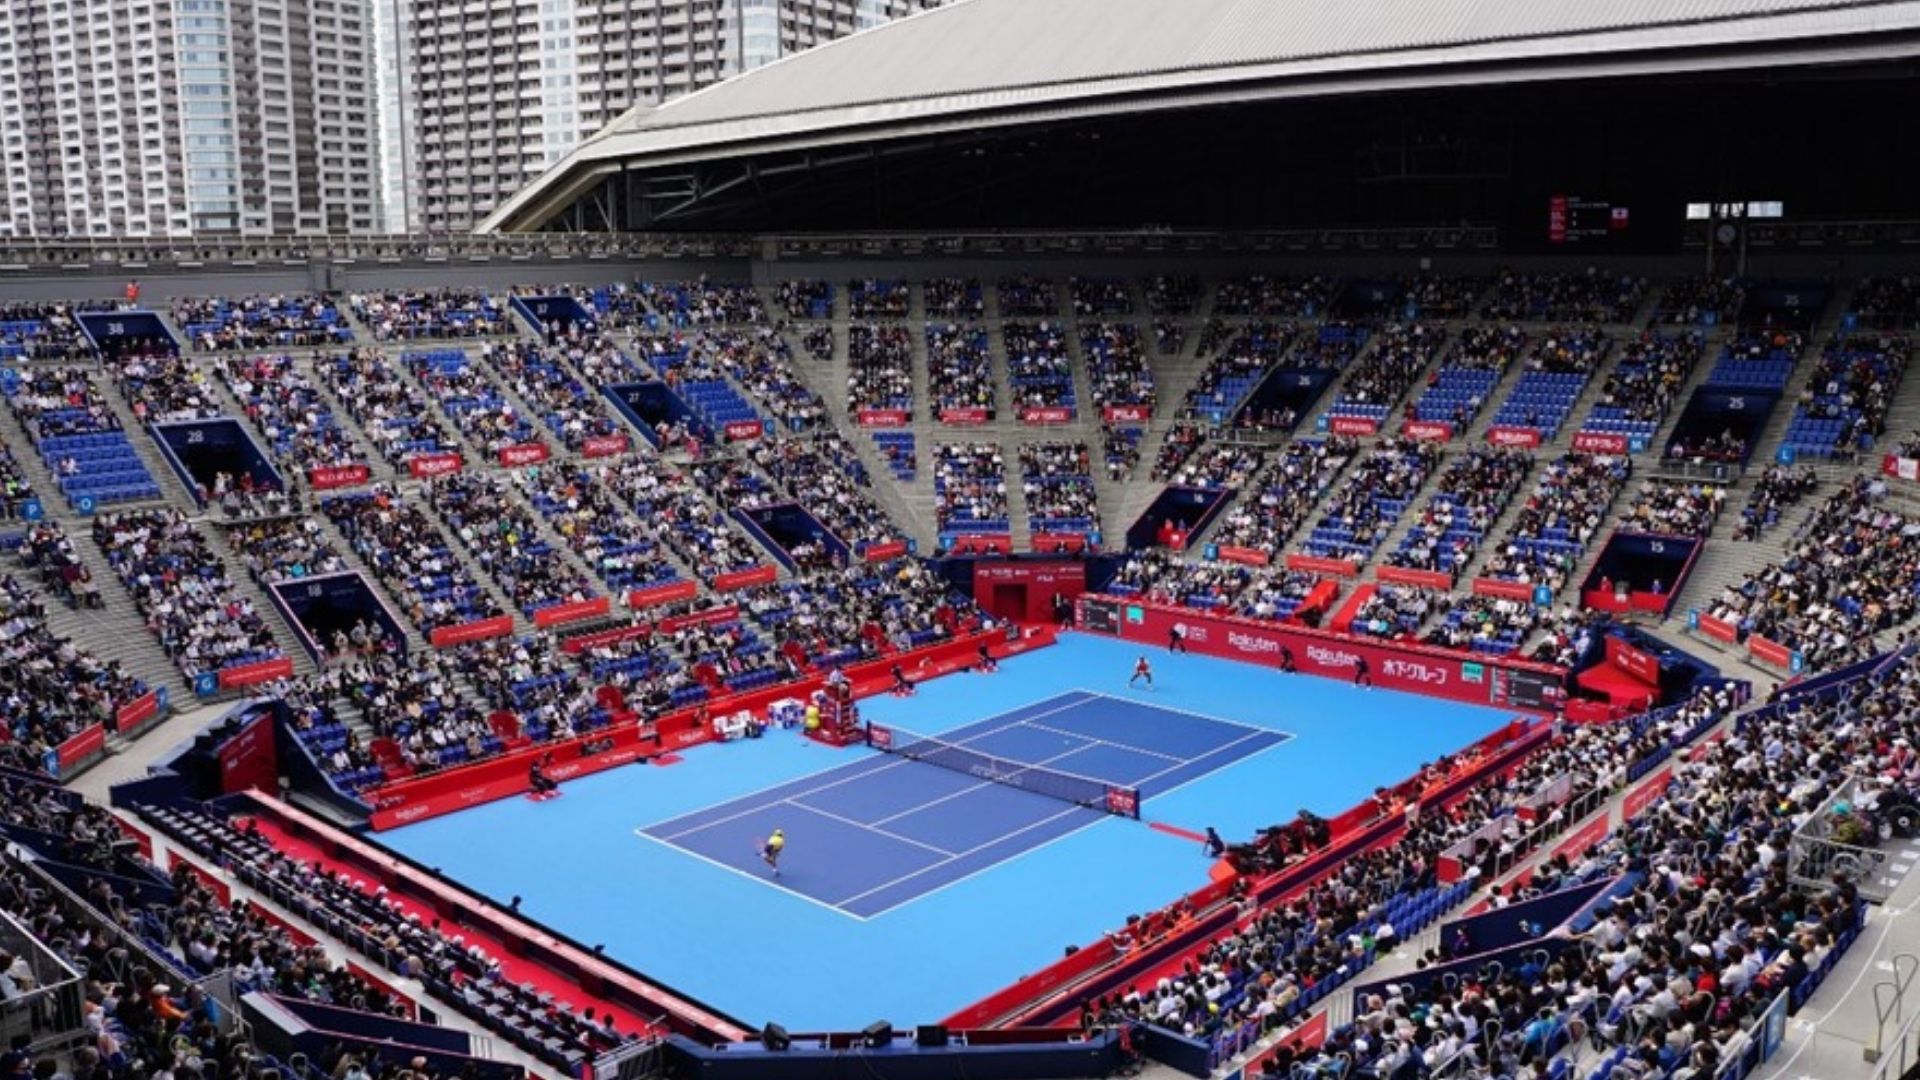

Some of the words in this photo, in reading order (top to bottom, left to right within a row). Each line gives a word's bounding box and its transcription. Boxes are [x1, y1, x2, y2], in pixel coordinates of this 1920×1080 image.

[107, 322, 125, 335] 38
[628, 392, 640, 403] 27
[1728, 396, 1745, 409] 25
[187, 430, 204, 444] 28
[29, 503, 38, 515] P
[1650, 541, 1664, 553] 15
[1228, 631, 1280, 652] Rakuten
[1383, 659, 1448, 685] 木下グループ
